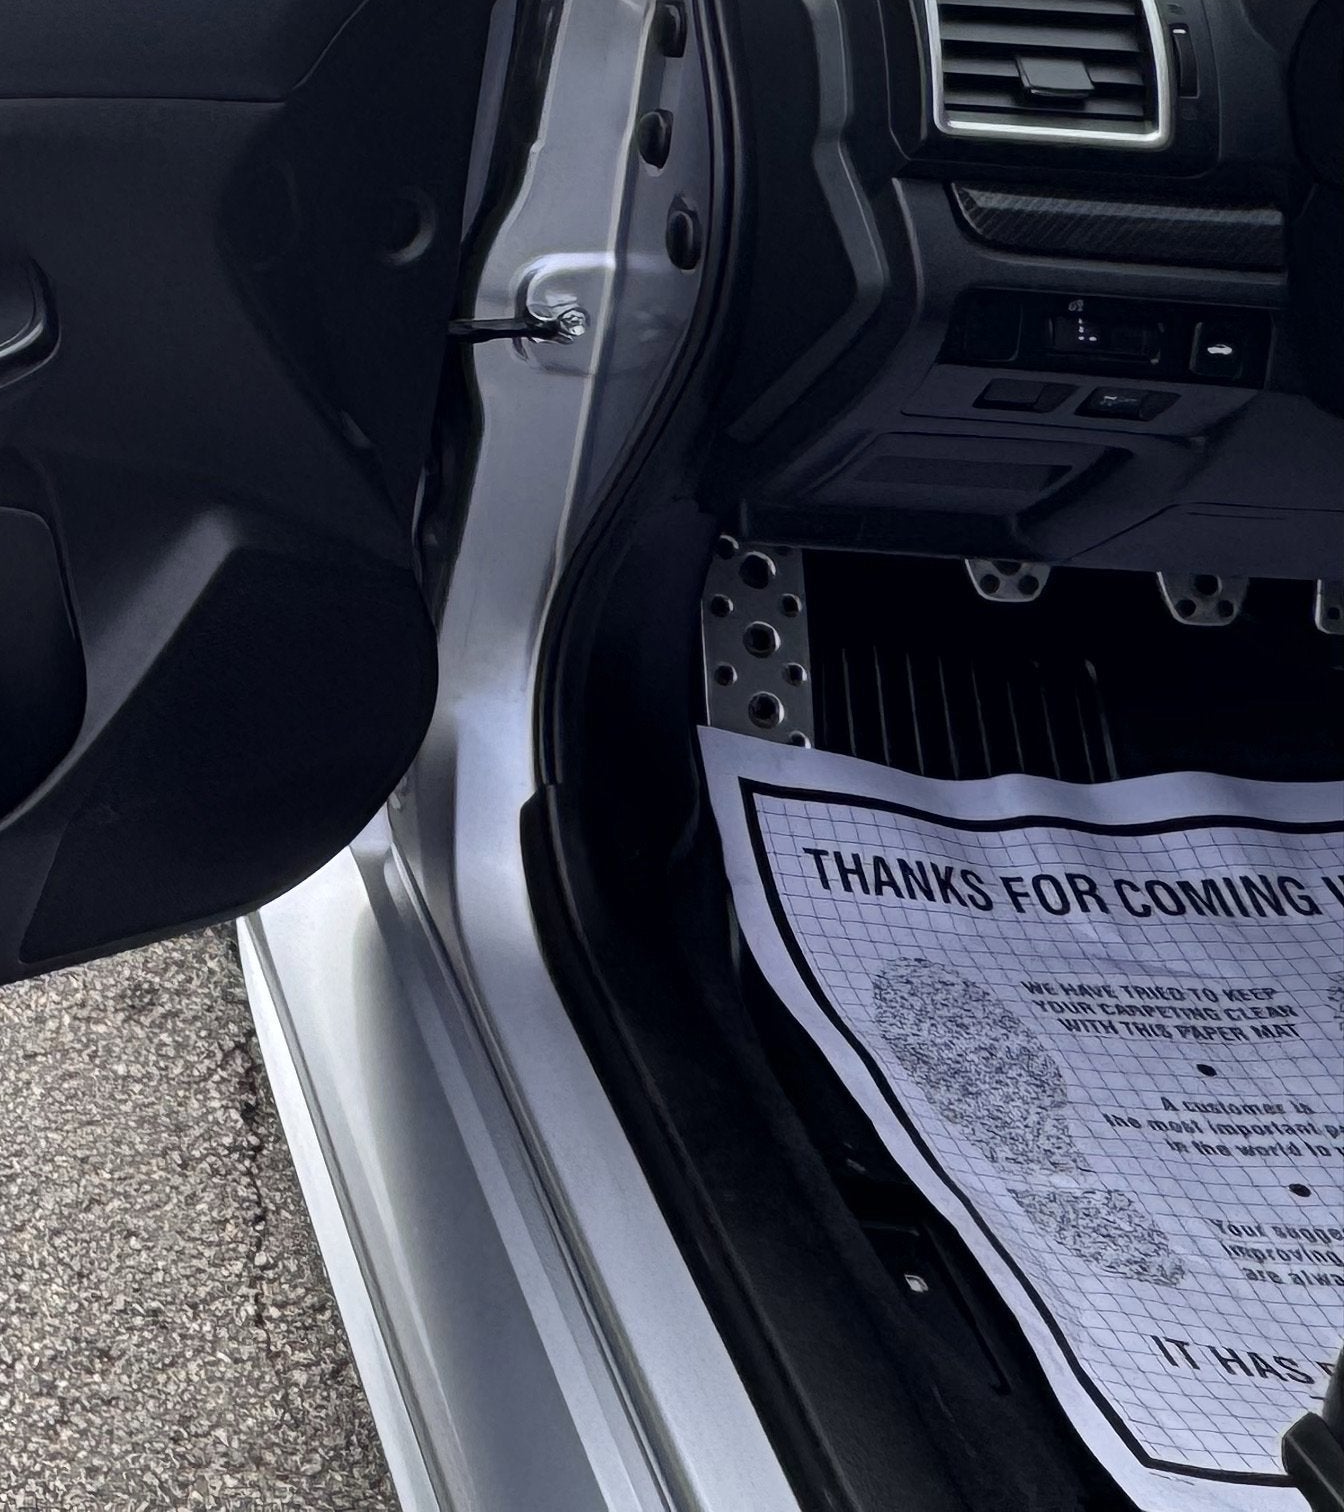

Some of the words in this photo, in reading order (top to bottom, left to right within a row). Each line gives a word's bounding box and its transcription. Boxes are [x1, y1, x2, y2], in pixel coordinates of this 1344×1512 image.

[802, 847, 994, 912] THANKS
[999, 872, 1110, 916] FOR
[1113, 874, 1323, 917] COMING
[1020, 981, 1058, 995] WE
[1059, 982, 1118, 999] HAVE
[1119, 985, 1185, 1001] TRIED
[1187, 987, 1219, 1003] TO
[1222, 987, 1277, 1002] KEEP
[1032, 999, 1096, 1015] YOUR
[1097, 1003, 1222, 1021] CARPETING
[1223, 1005, 1299, 1021] CLEAN
[1057, 1018, 1119, 1034] WITH
[1119, 1021, 1173, 1039] THIS
[1173, 1025, 1250, 1041] PAPER
[1249, 1023, 1300, 1038] MAT
[1160, 1096, 1179, 1111] A
[1182, 1100, 1286, 1115] customer
[1289, 1100, 1315, 1115] is
[1102, 1113, 1142, 1129] the
[1146, 1119, 1204, 1134] most
[1206, 1120, 1321, 1138] important
[1191, 1139, 1232, 1156] the
[1235, 1141, 1304, 1157] world
[1304, 1141, 1332, 1158] to
[1209, 1219, 1268, 1238] Your
[1271, 1225, 1344, 1244] sugge
[1243, 1267, 1287, 1284] are
[1288, 1270, 1344, 1286] alwa
[1149, 1334, 1201, 1370] IT
[1207, 1345, 1315, 1385] HAS
